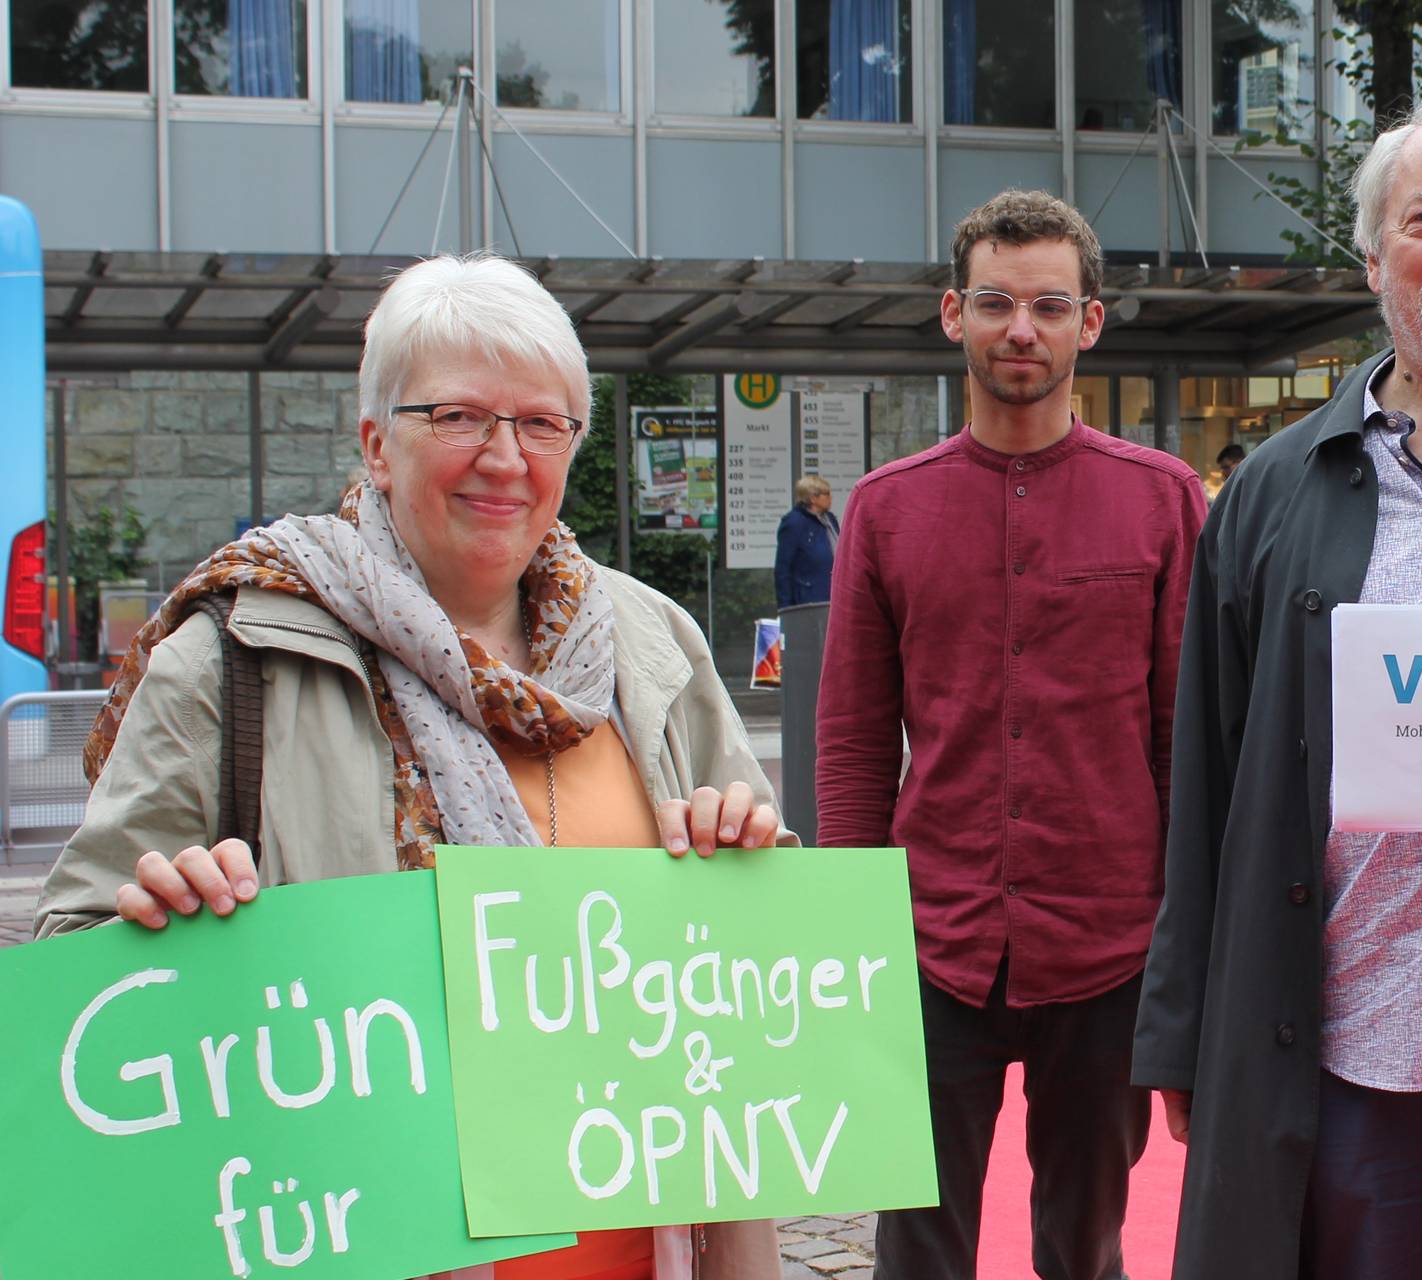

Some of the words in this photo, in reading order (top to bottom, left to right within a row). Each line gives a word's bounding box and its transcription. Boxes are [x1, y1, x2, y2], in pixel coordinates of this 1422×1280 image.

[748, 374, 768, 399] H
[804, 416, 819, 425] 455
[745, 424, 770, 432] Markt
[728, 444, 744, 453] 227
[728, 459, 744, 467] 335
[728, 473, 744, 481] 400
[729, 501, 745, 509] 427
[729, 514, 745, 523] 434
[729, 528, 745, 537] 436
[730, 543, 746, 551] 439
[472, 888, 890, 1060] Fußgänger
[60, 966, 428, 1137] Grün
[683, 1030, 735, 1097] &
[566, 1079, 850, 1210] ÖPNV
[214, 1155, 362, 1280] für
